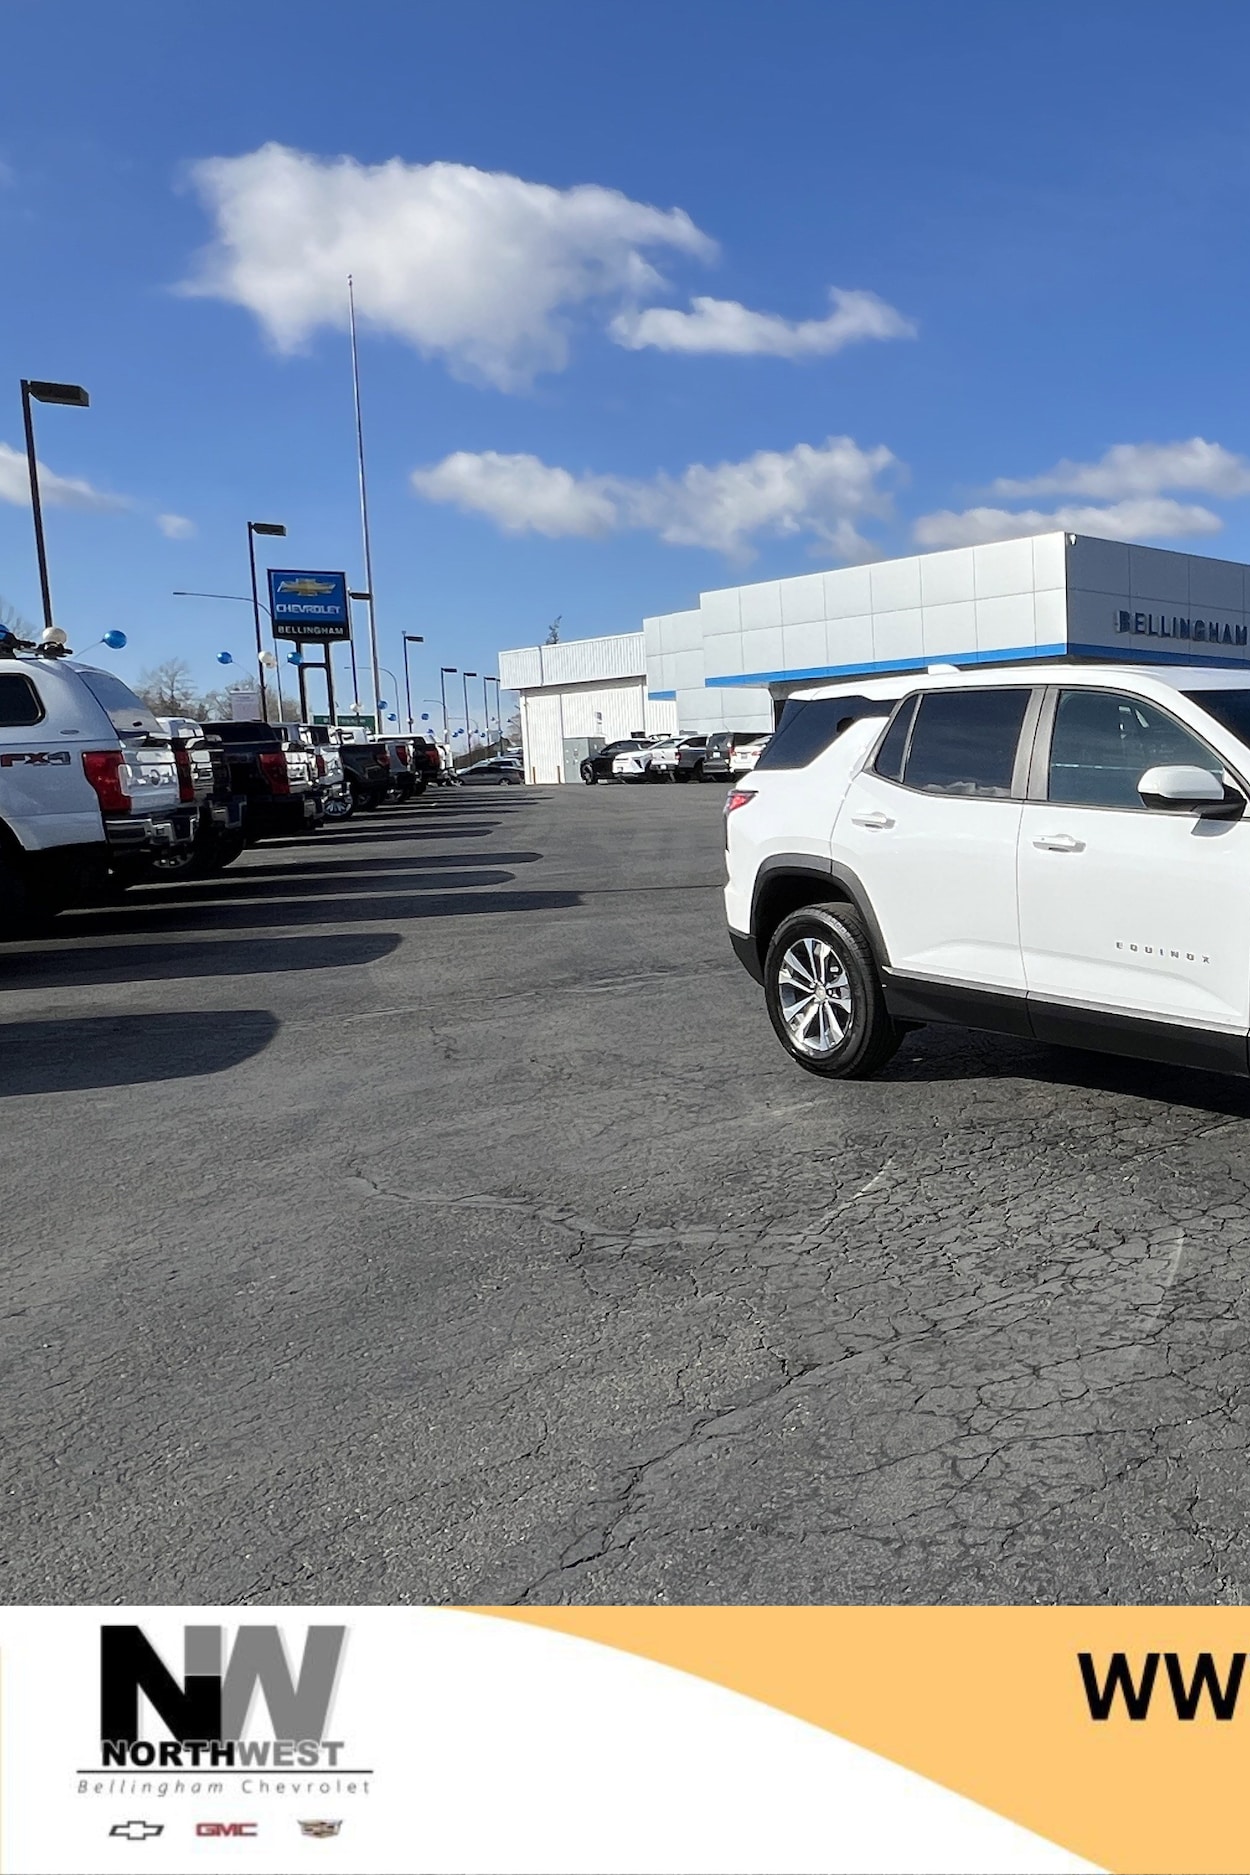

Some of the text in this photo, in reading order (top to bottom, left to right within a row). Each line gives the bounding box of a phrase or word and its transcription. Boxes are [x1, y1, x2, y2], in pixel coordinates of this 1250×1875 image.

[276, 603, 341, 615] CHEVROLET
[277, 625, 344, 635] BELLINGHAM
[1115, 610, 1248, 646] BELLINGHAM
[0, 751, 71, 767] FX4
[1116, 941, 1210, 964] EQUINOX
